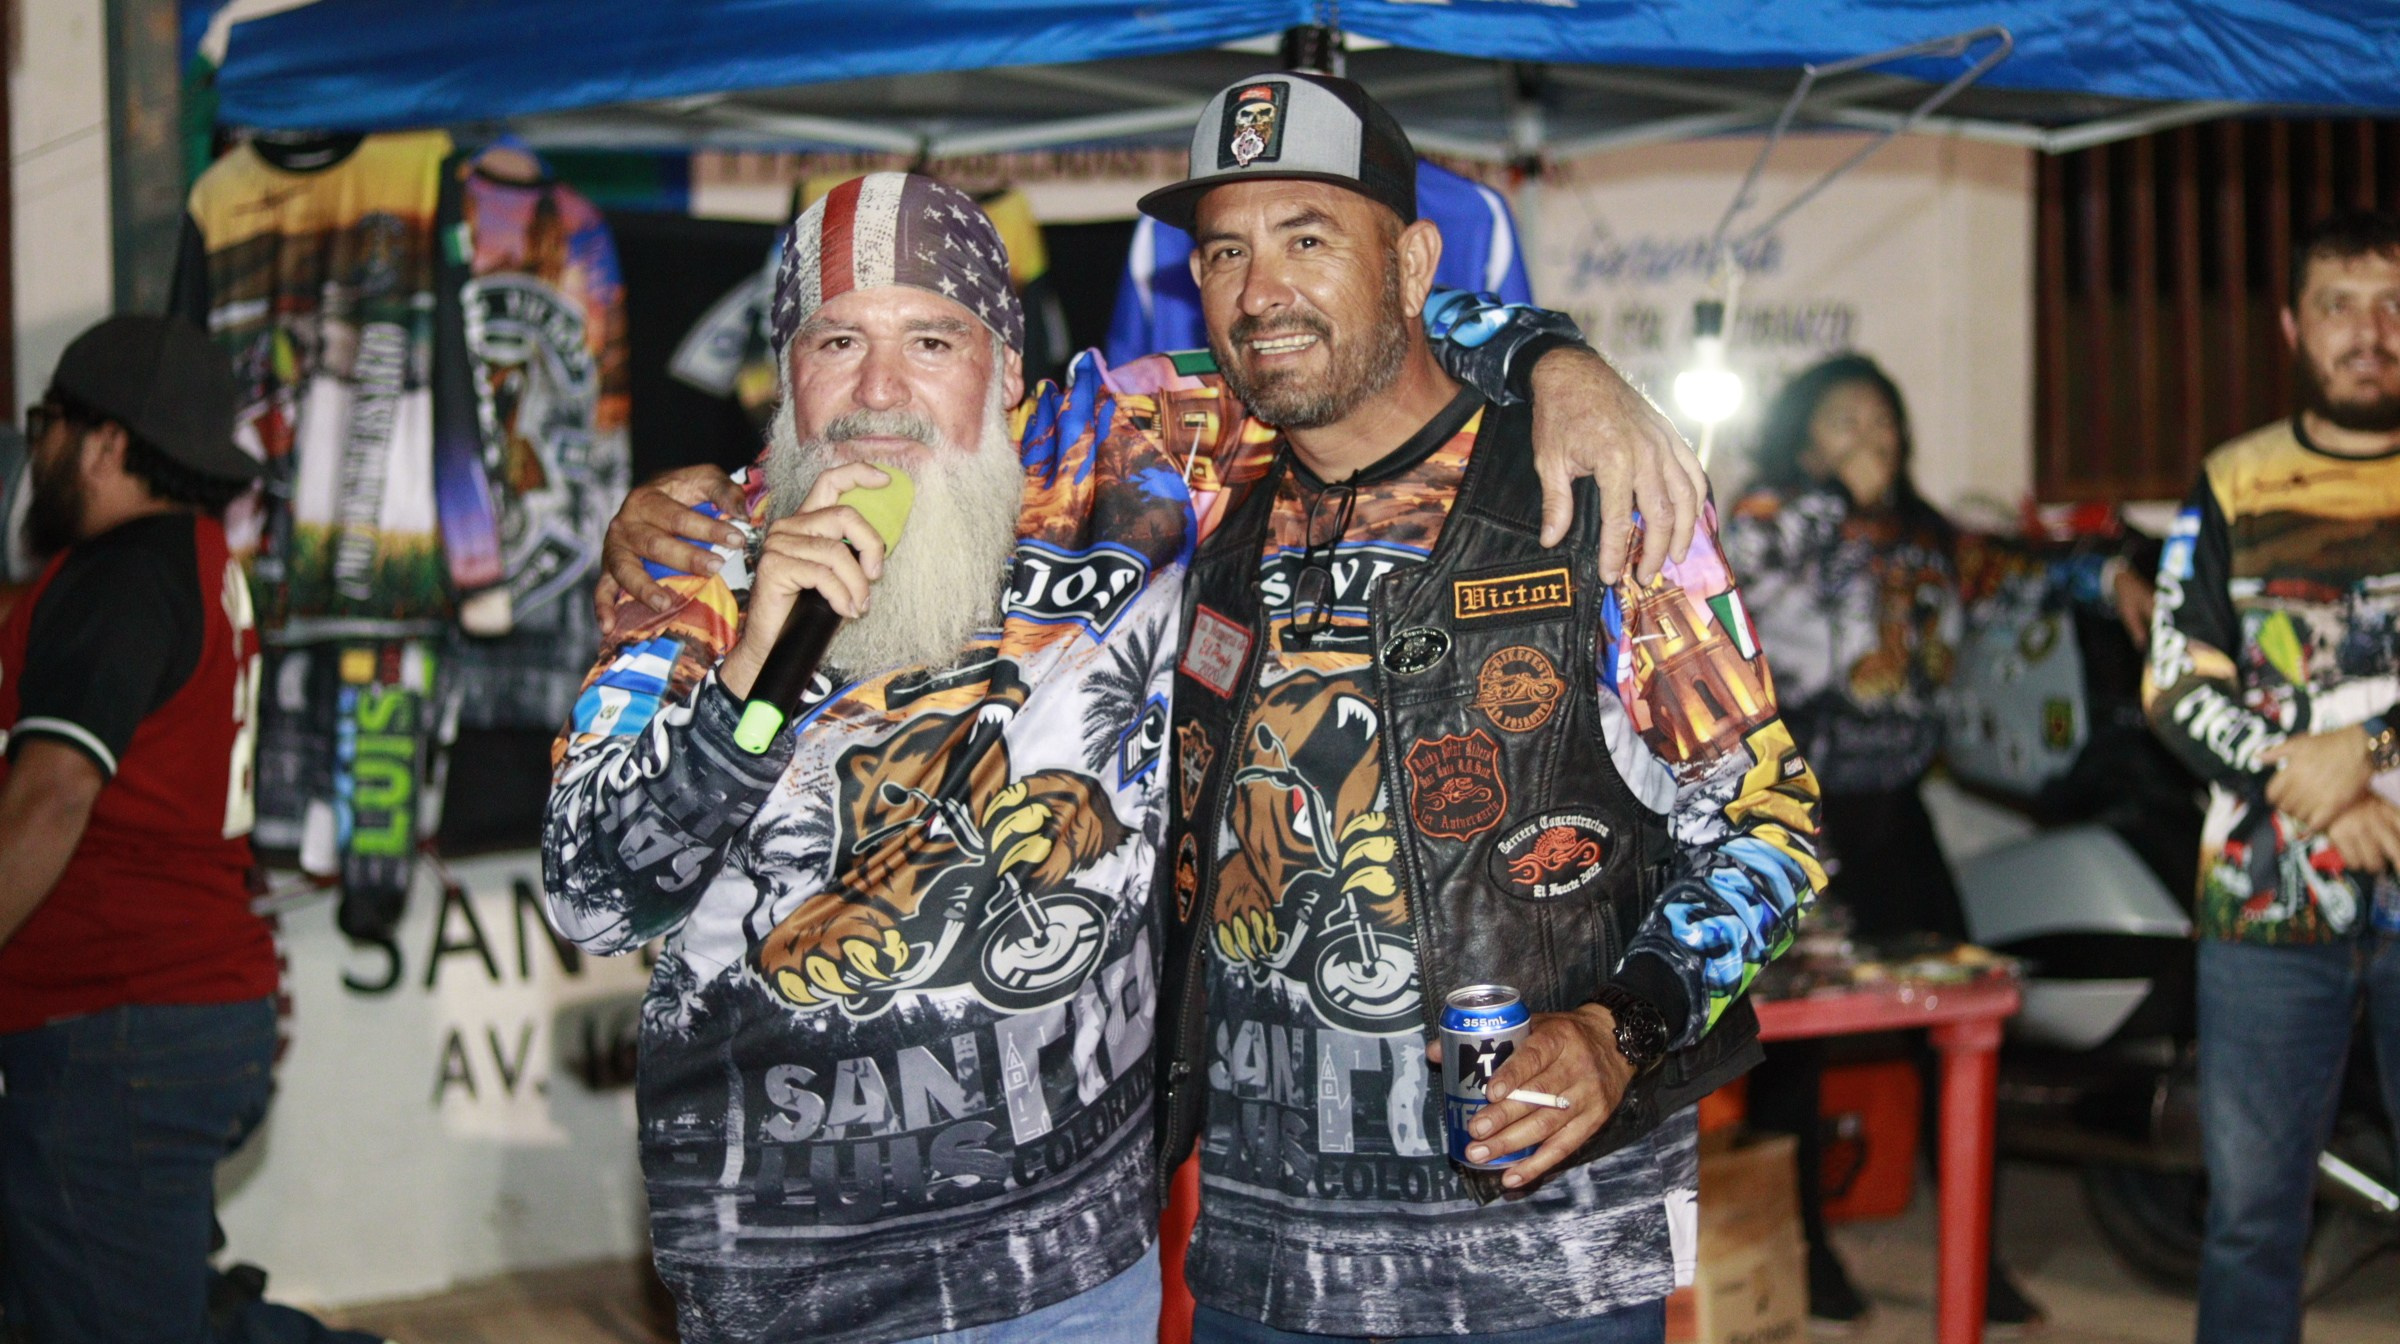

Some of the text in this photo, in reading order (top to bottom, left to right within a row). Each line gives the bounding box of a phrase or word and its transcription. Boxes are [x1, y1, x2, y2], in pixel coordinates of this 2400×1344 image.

[1461, 583, 1563, 611] Victor
[351, 689, 417, 857] LUIS
[1579, 862, 1603, 884] 2022
[1462, 1016, 1508, 1029] 355mL
[429, 1019, 546, 1107] AV.
